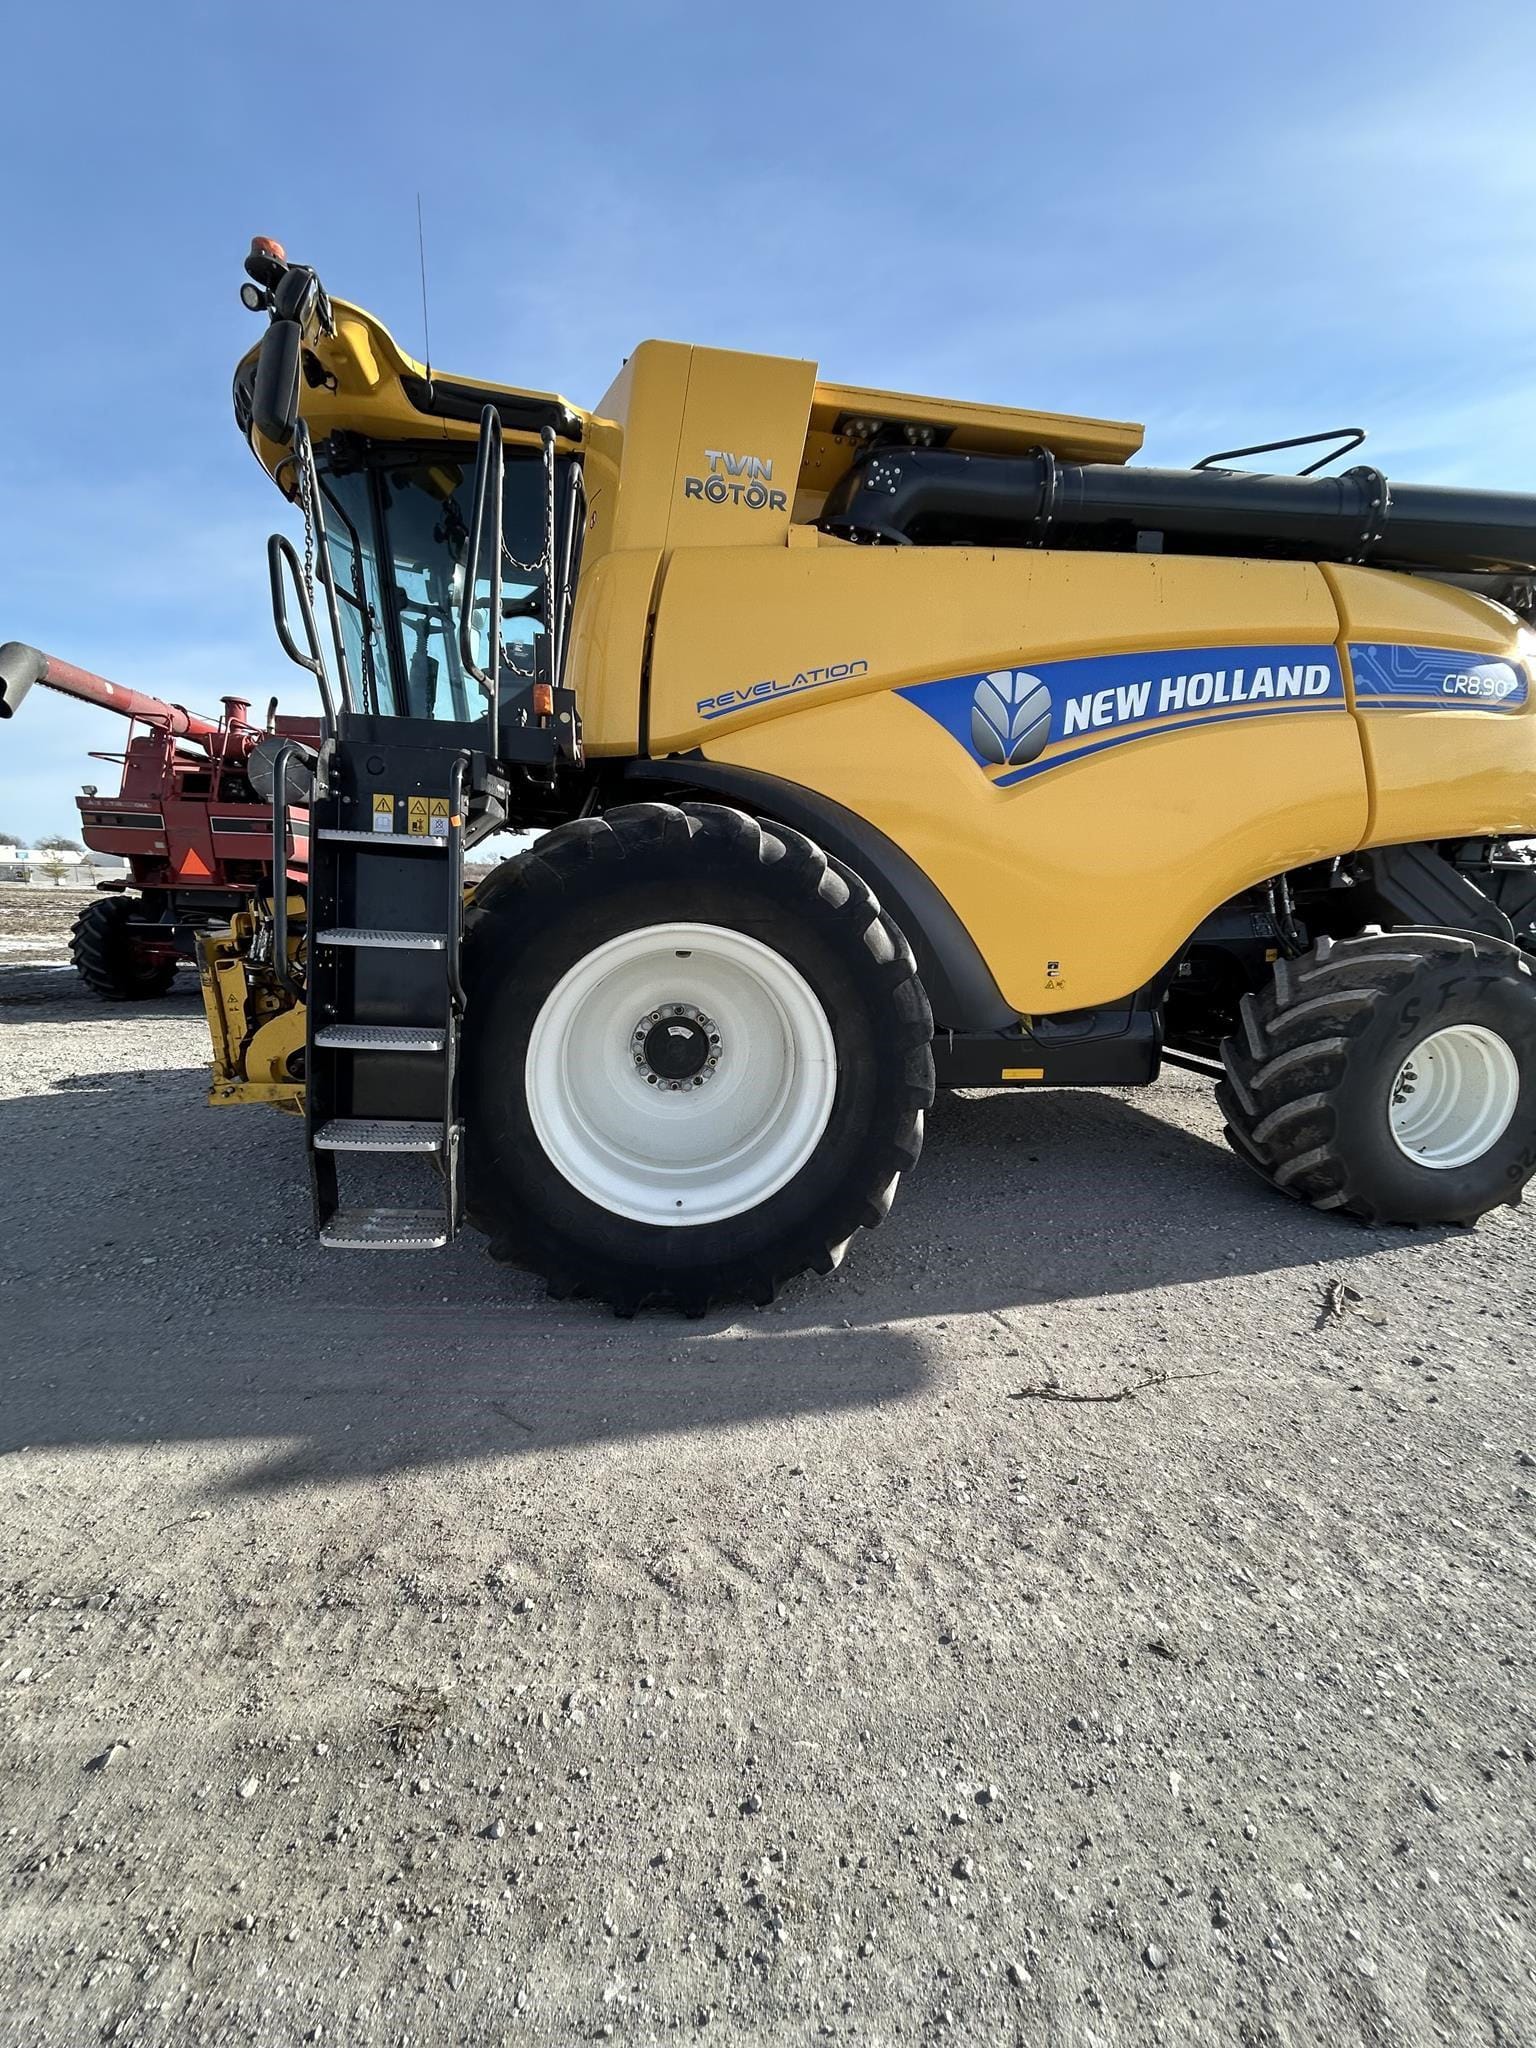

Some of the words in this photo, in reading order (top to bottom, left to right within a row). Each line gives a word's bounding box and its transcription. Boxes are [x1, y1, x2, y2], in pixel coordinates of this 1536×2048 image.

[704, 449, 773, 481] TWIN
[684, 473, 788, 512] ROTOR
[696, 659, 869, 714] REVELATION
[1062, 679, 1153, 736] NEW
[1158, 664, 1331, 714] HOLLAND
[1442, 673, 1506, 698] CR8.90
